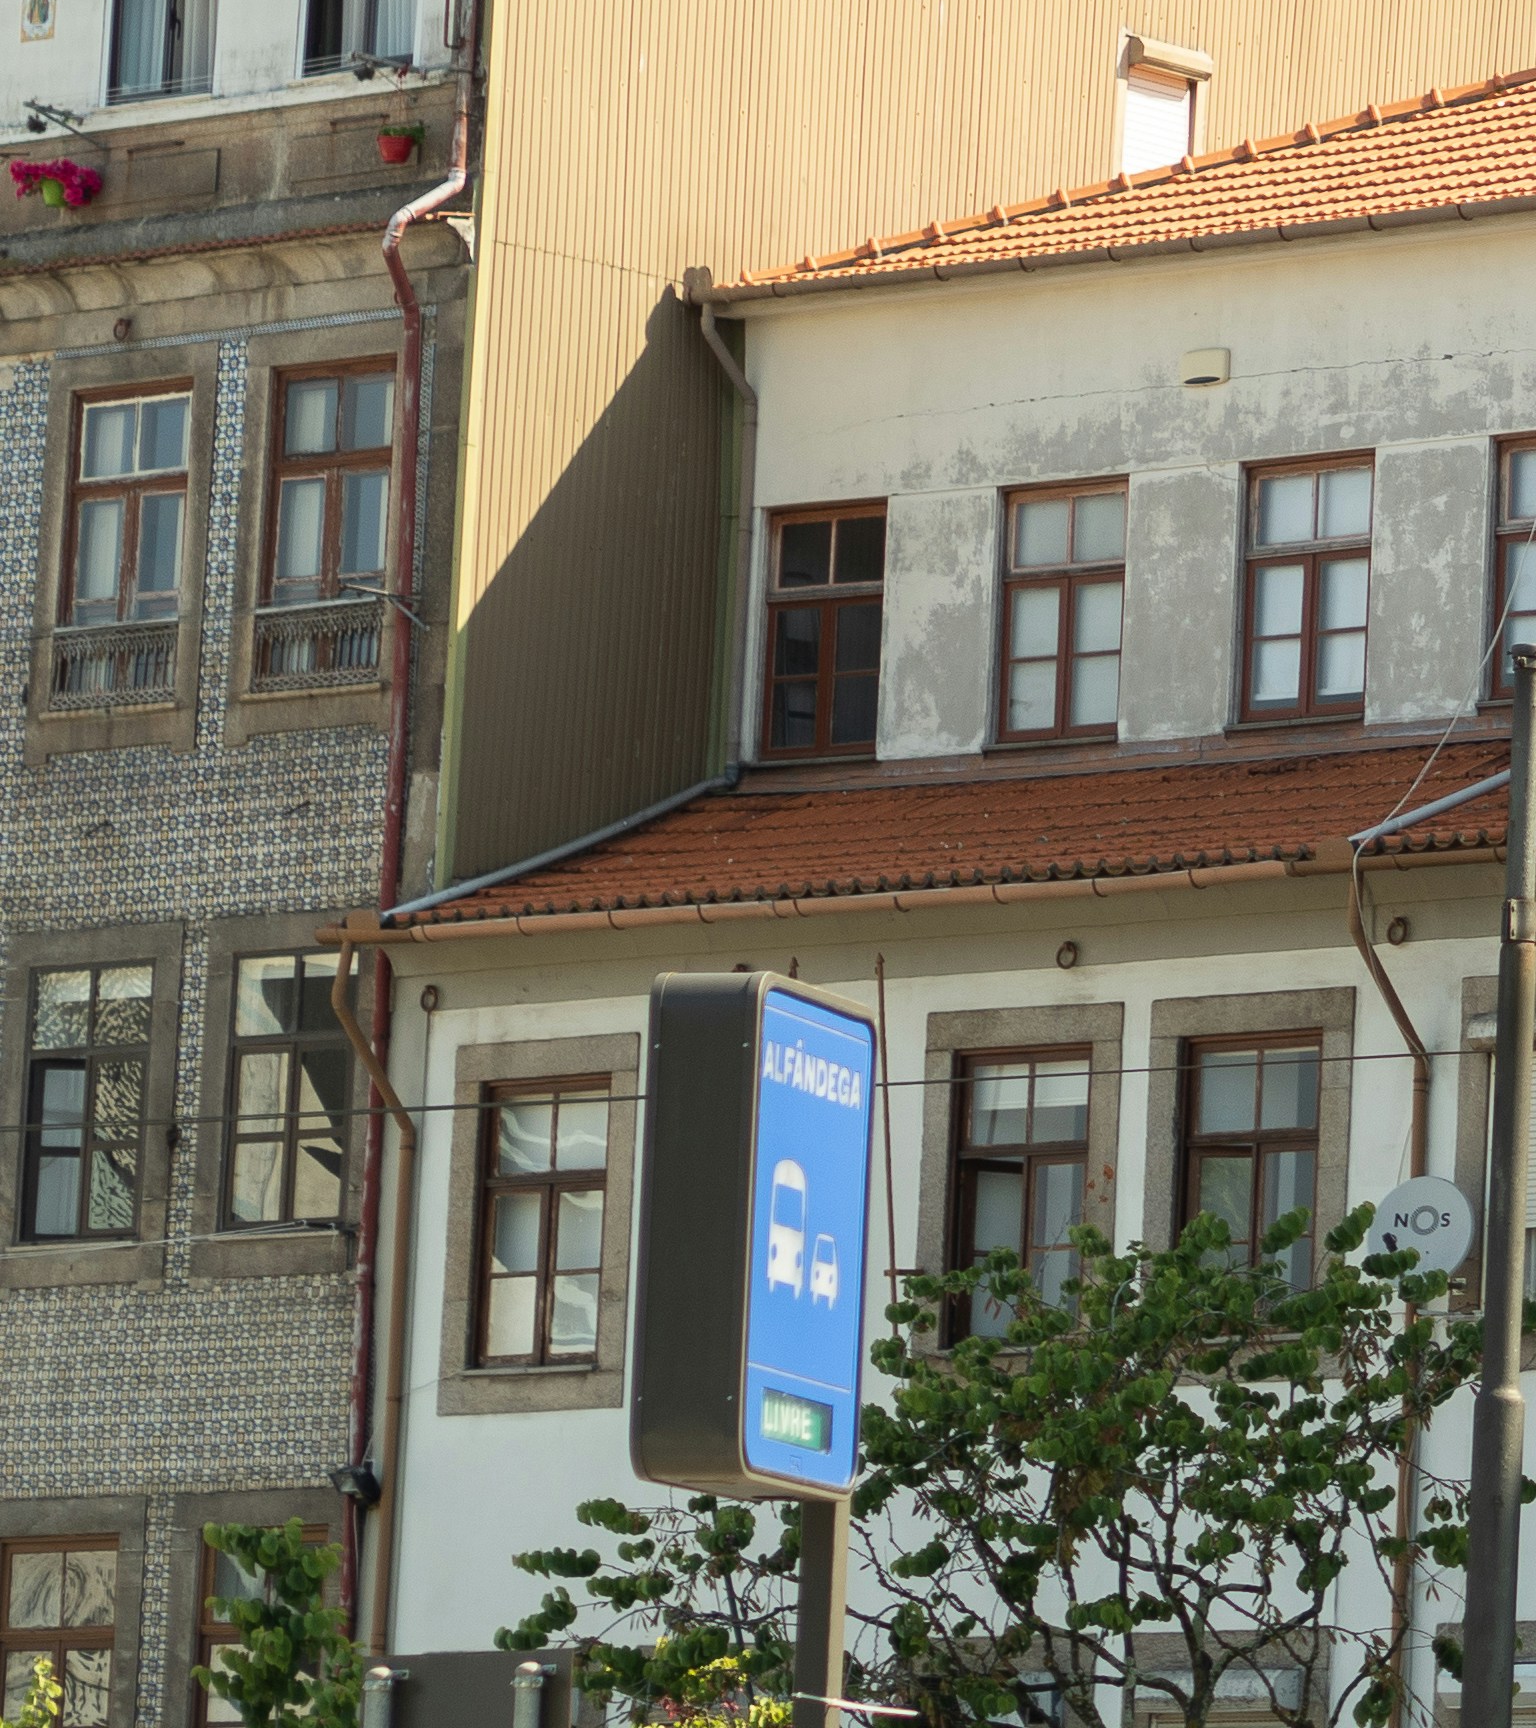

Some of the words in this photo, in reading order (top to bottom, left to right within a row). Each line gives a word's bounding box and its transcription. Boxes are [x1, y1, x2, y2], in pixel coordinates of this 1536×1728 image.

[763, 1038, 861, 1110] ALFÂNDEGA
[1394, 1205, 1451, 1235] NOS
[763, 1399, 812, 1441] LIVRE
